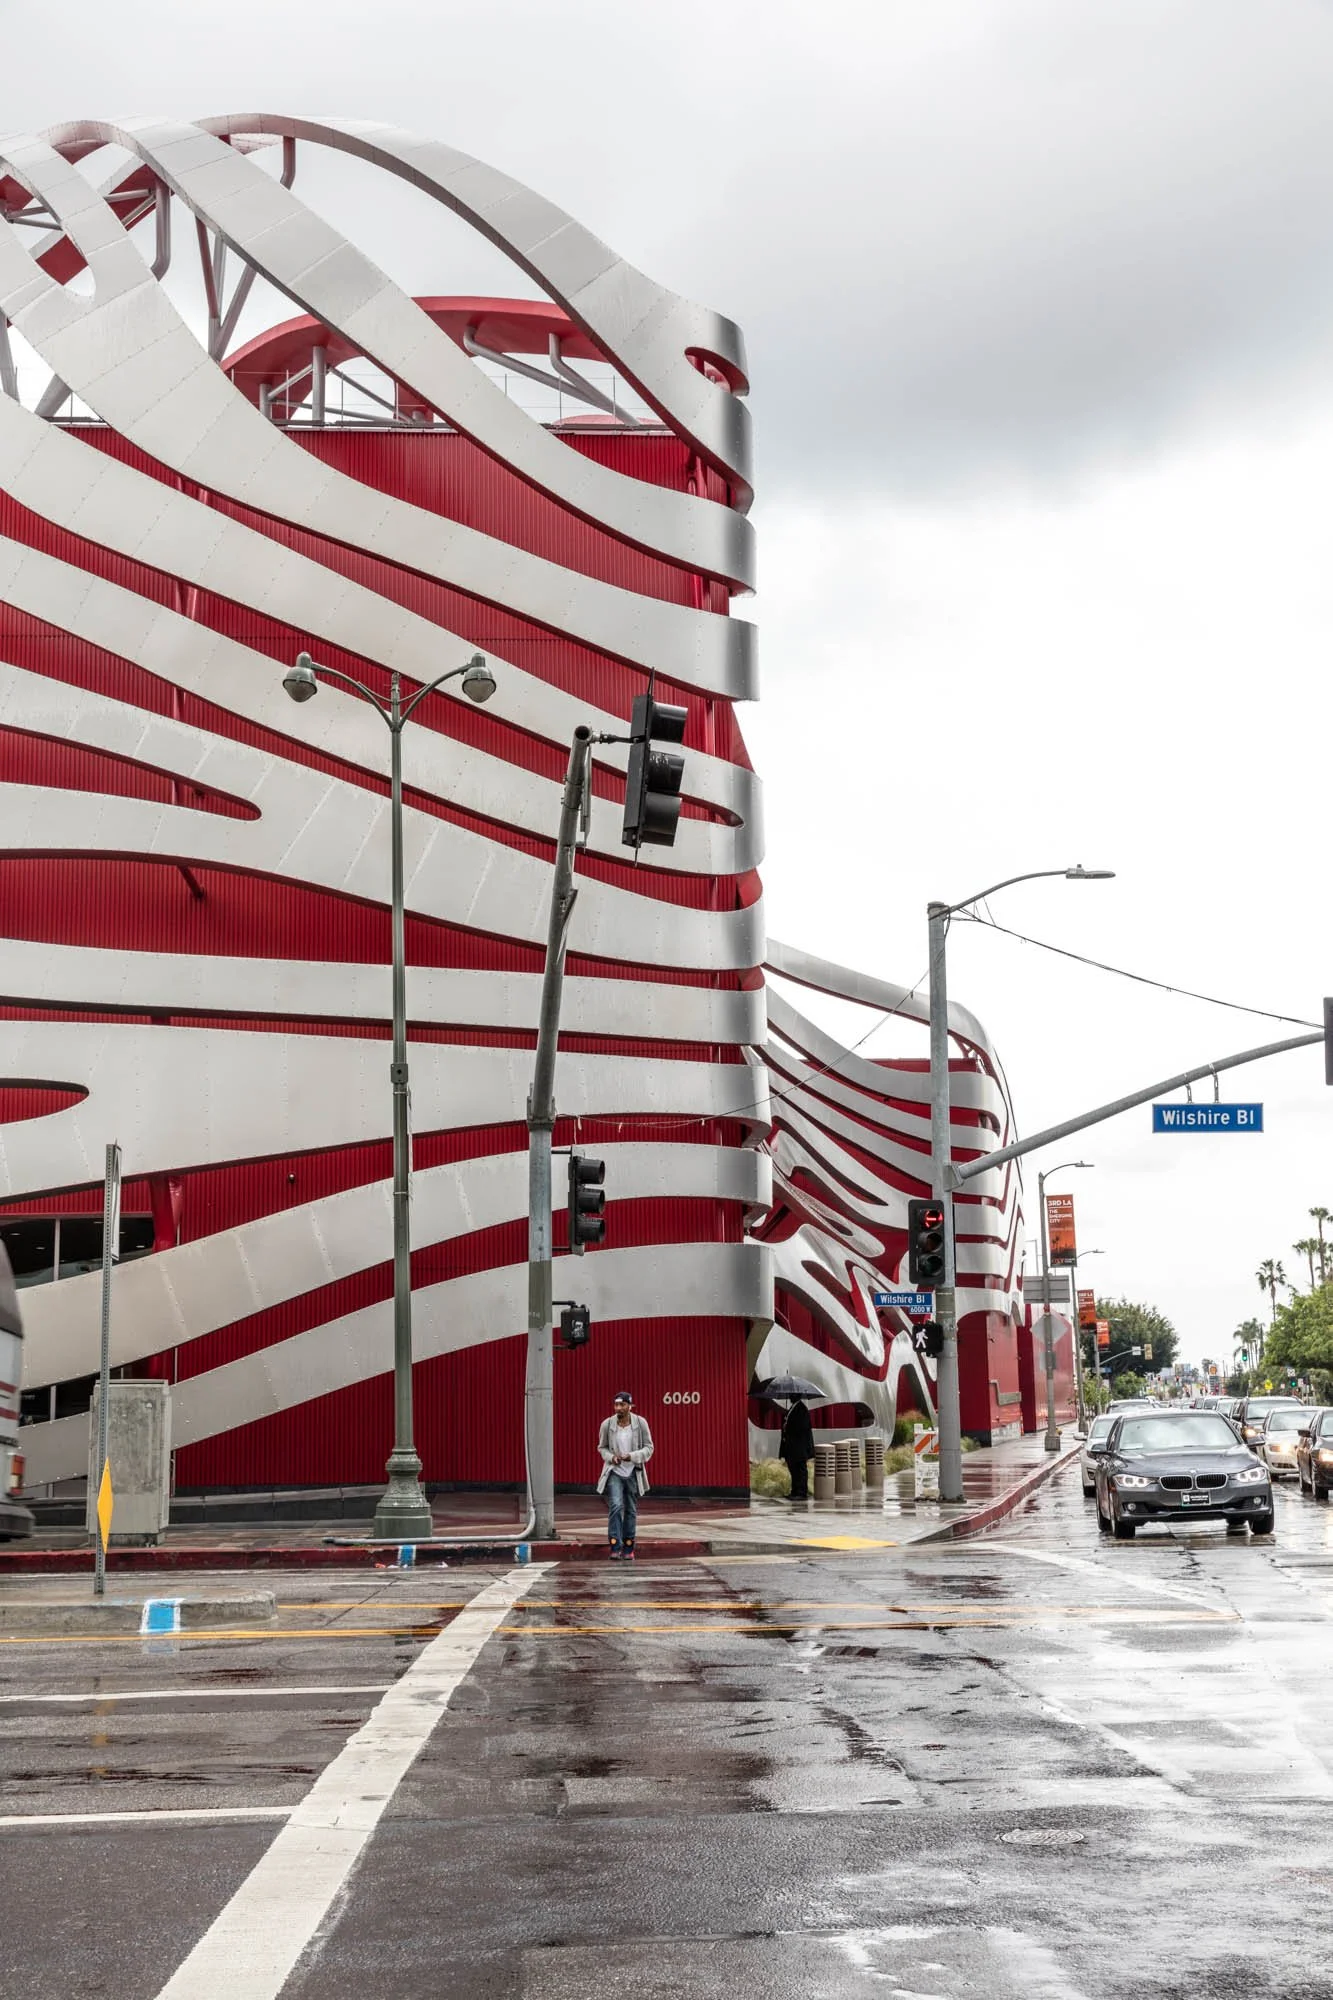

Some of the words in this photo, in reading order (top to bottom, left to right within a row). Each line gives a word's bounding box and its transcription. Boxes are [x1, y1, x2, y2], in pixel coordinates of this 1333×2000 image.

[1162, 1110, 1230, 1125] Wilshire
[1237, 1110, 1254, 1124] Bl
[880, 1295, 913, 1304] Wilshire
[916, 1295, 925, 1303] Bl
[662, 1391, 701, 1405] 6060
